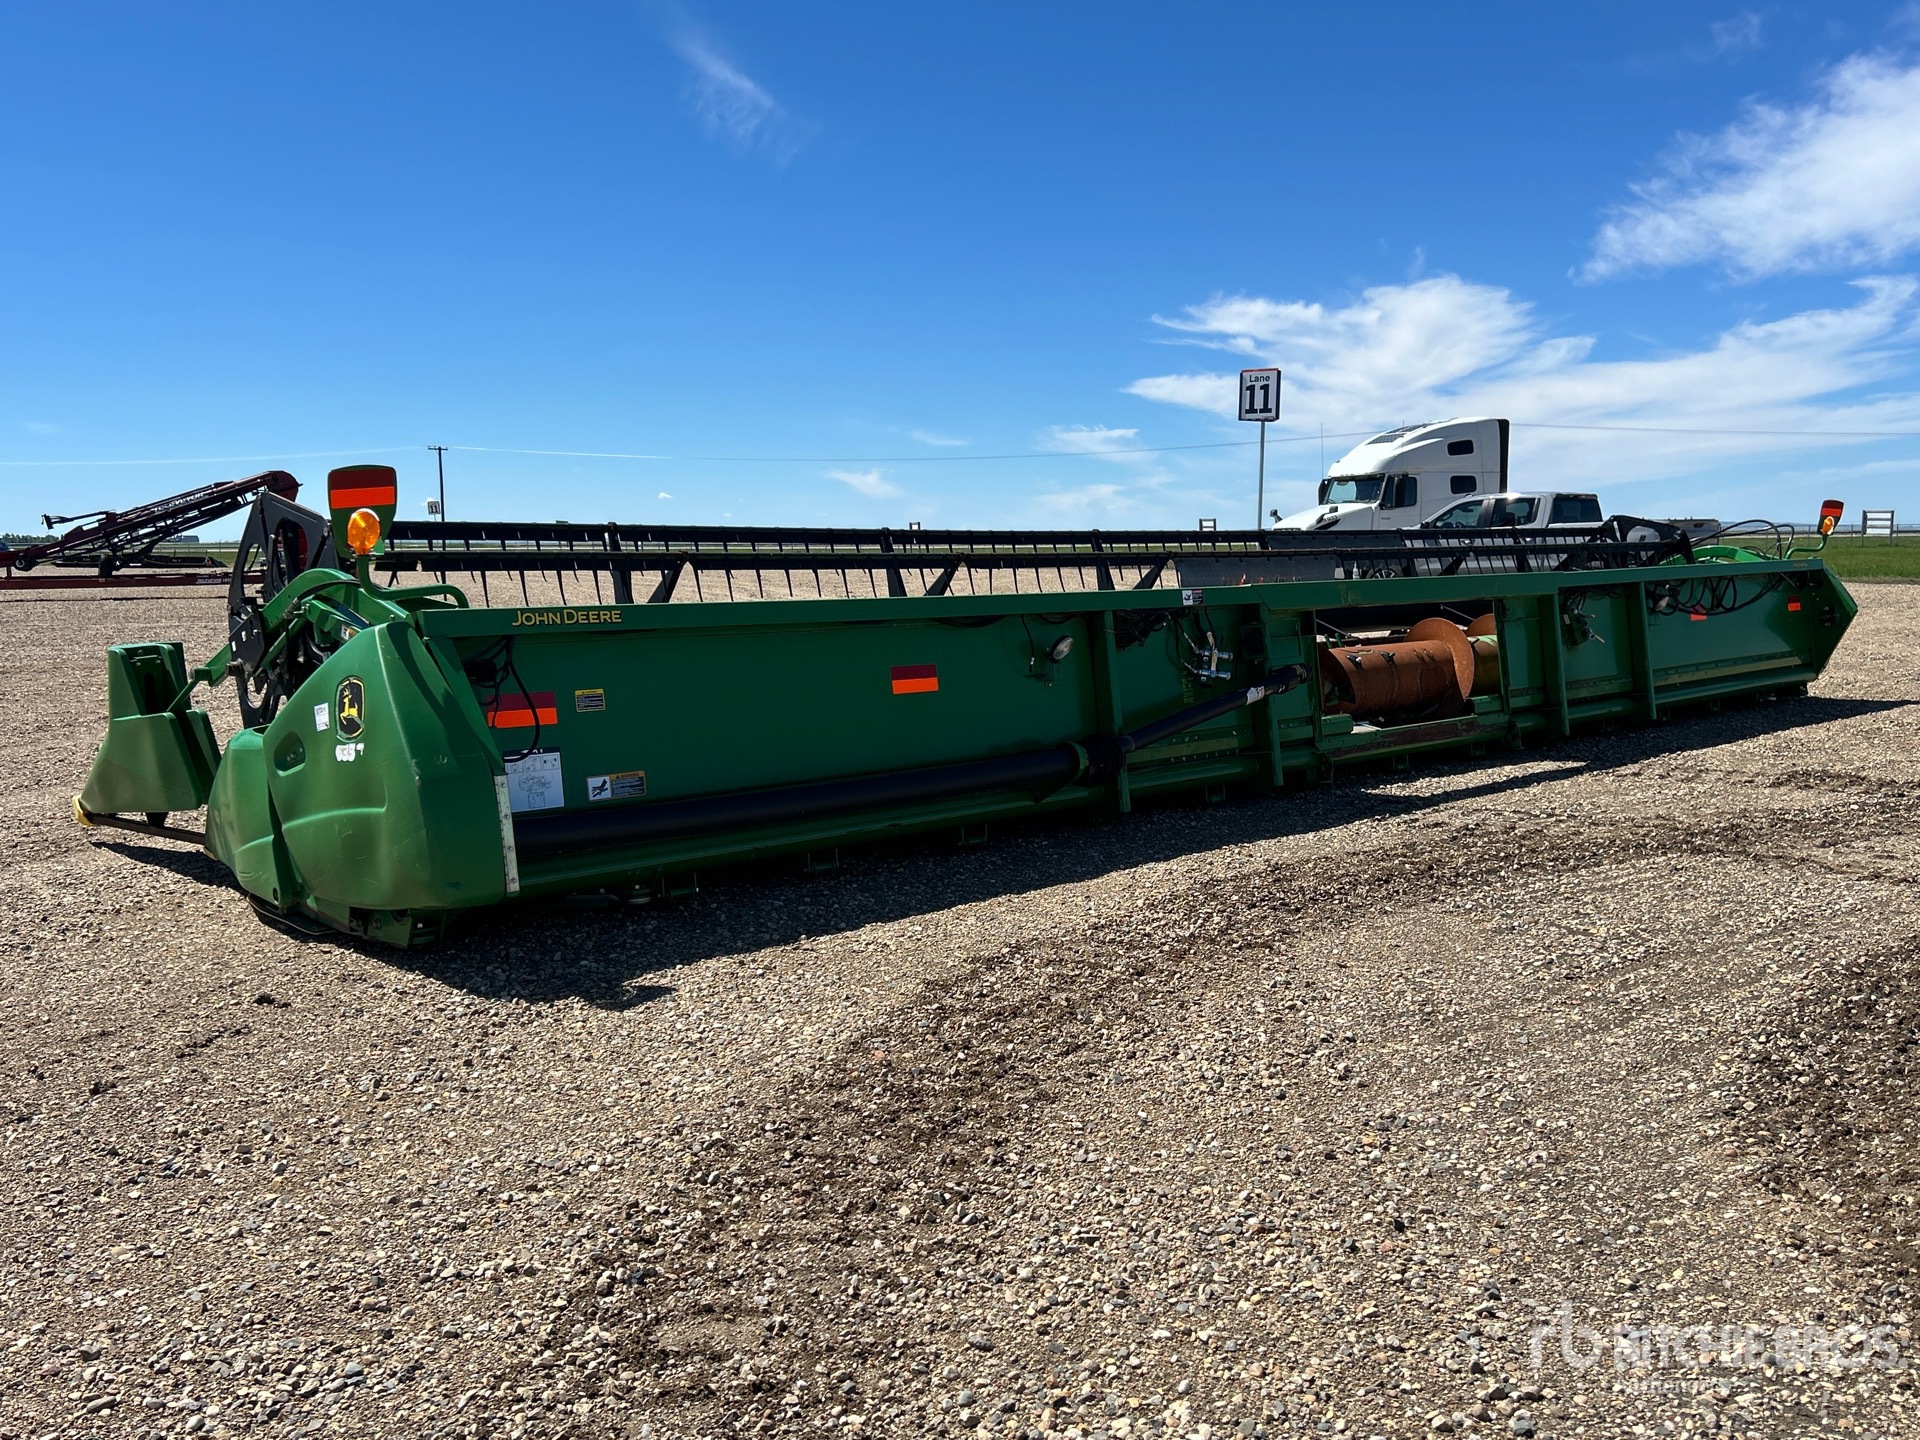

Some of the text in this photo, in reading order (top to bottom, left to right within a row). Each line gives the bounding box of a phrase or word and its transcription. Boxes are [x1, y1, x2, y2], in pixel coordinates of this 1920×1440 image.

[1249, 374, 1270, 383] Lane
[1245, 383, 1272, 414] 11
[512, 609, 622, 627] JOHN DEERE
